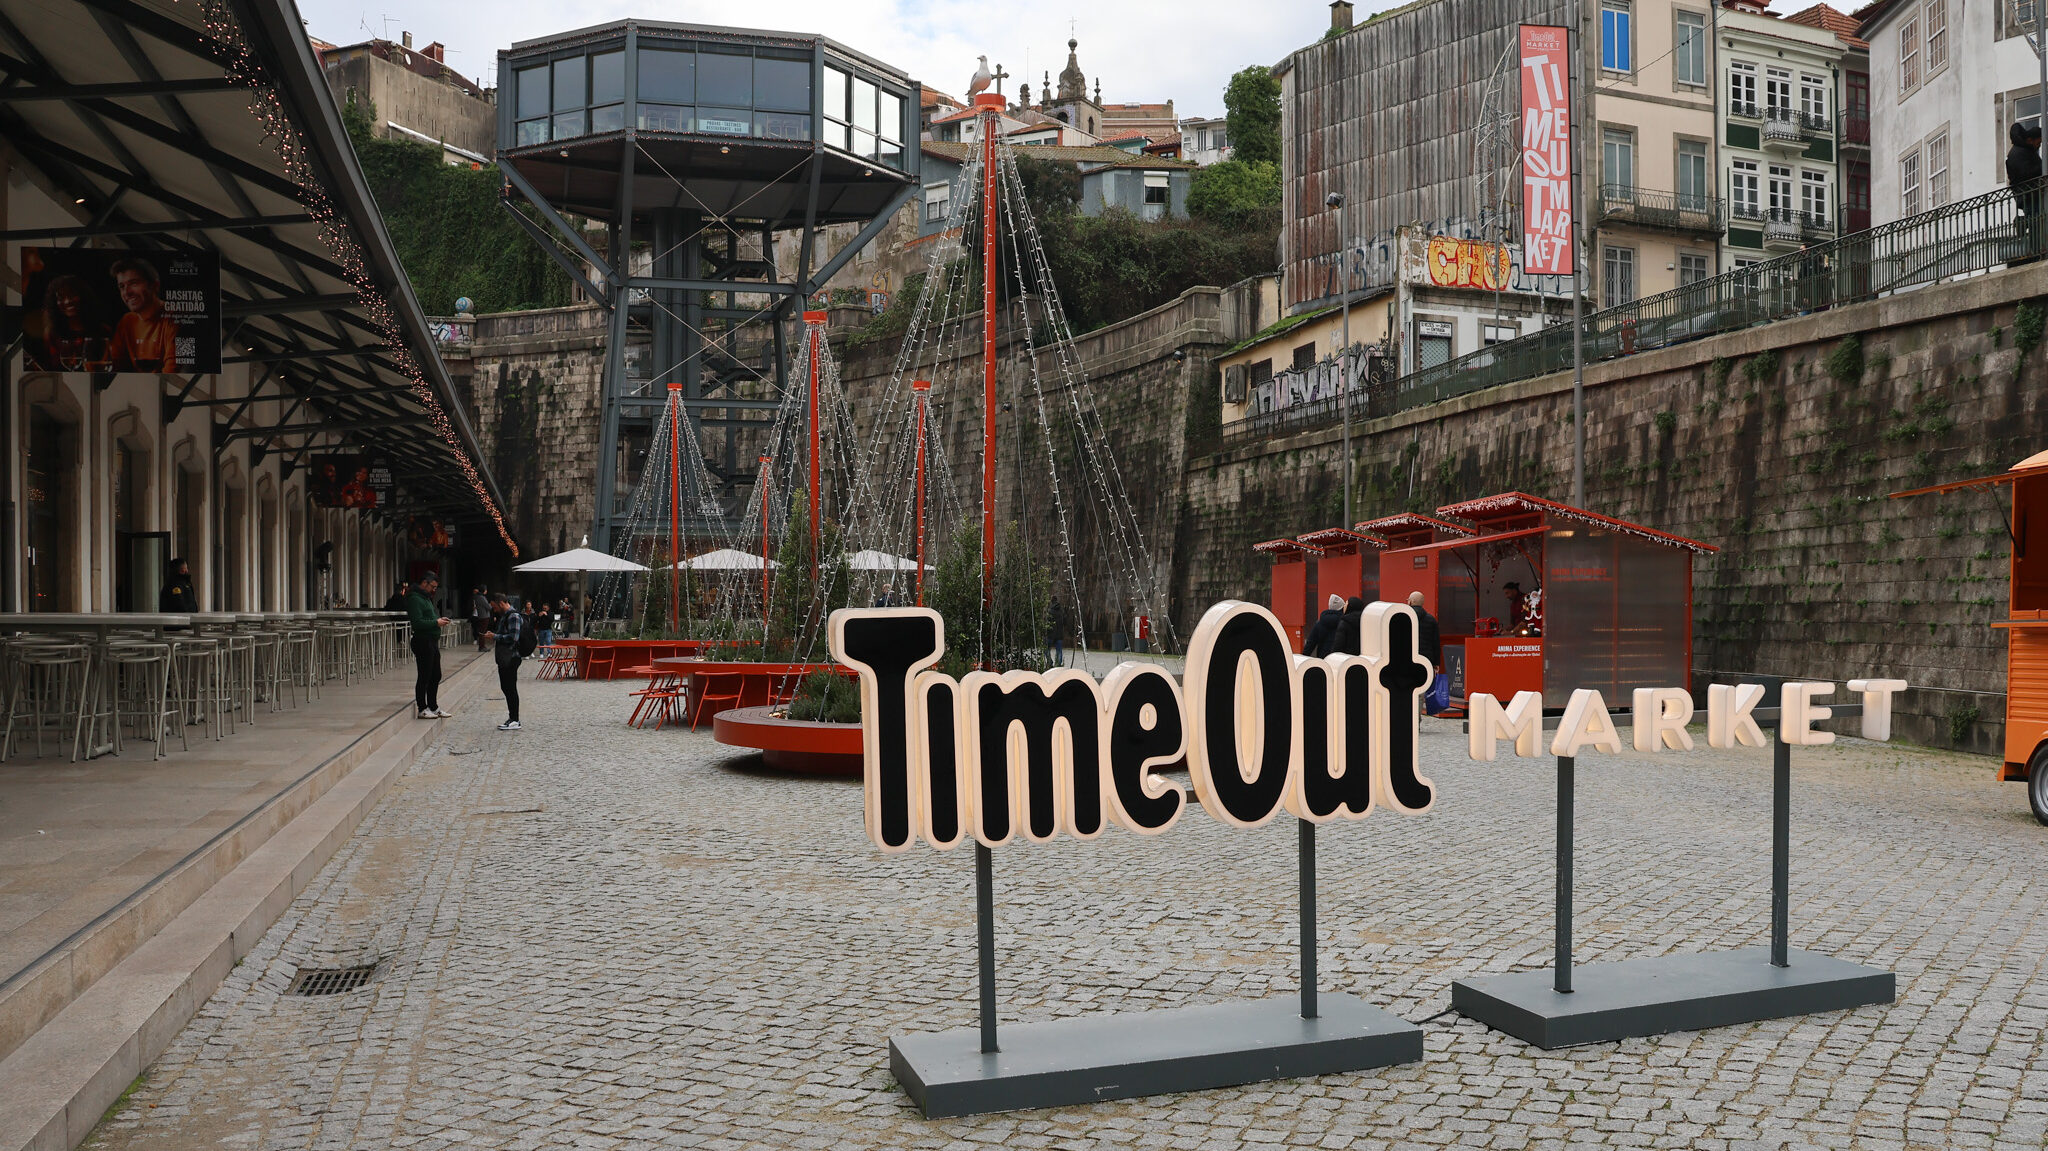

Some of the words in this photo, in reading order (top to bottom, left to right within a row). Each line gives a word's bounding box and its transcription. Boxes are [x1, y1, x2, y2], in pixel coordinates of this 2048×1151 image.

[166, 290, 204, 301] HASHTAG
[164, 300, 205, 312] GRATIDÃO
[1468, 679, 1908, 762] MARKET
